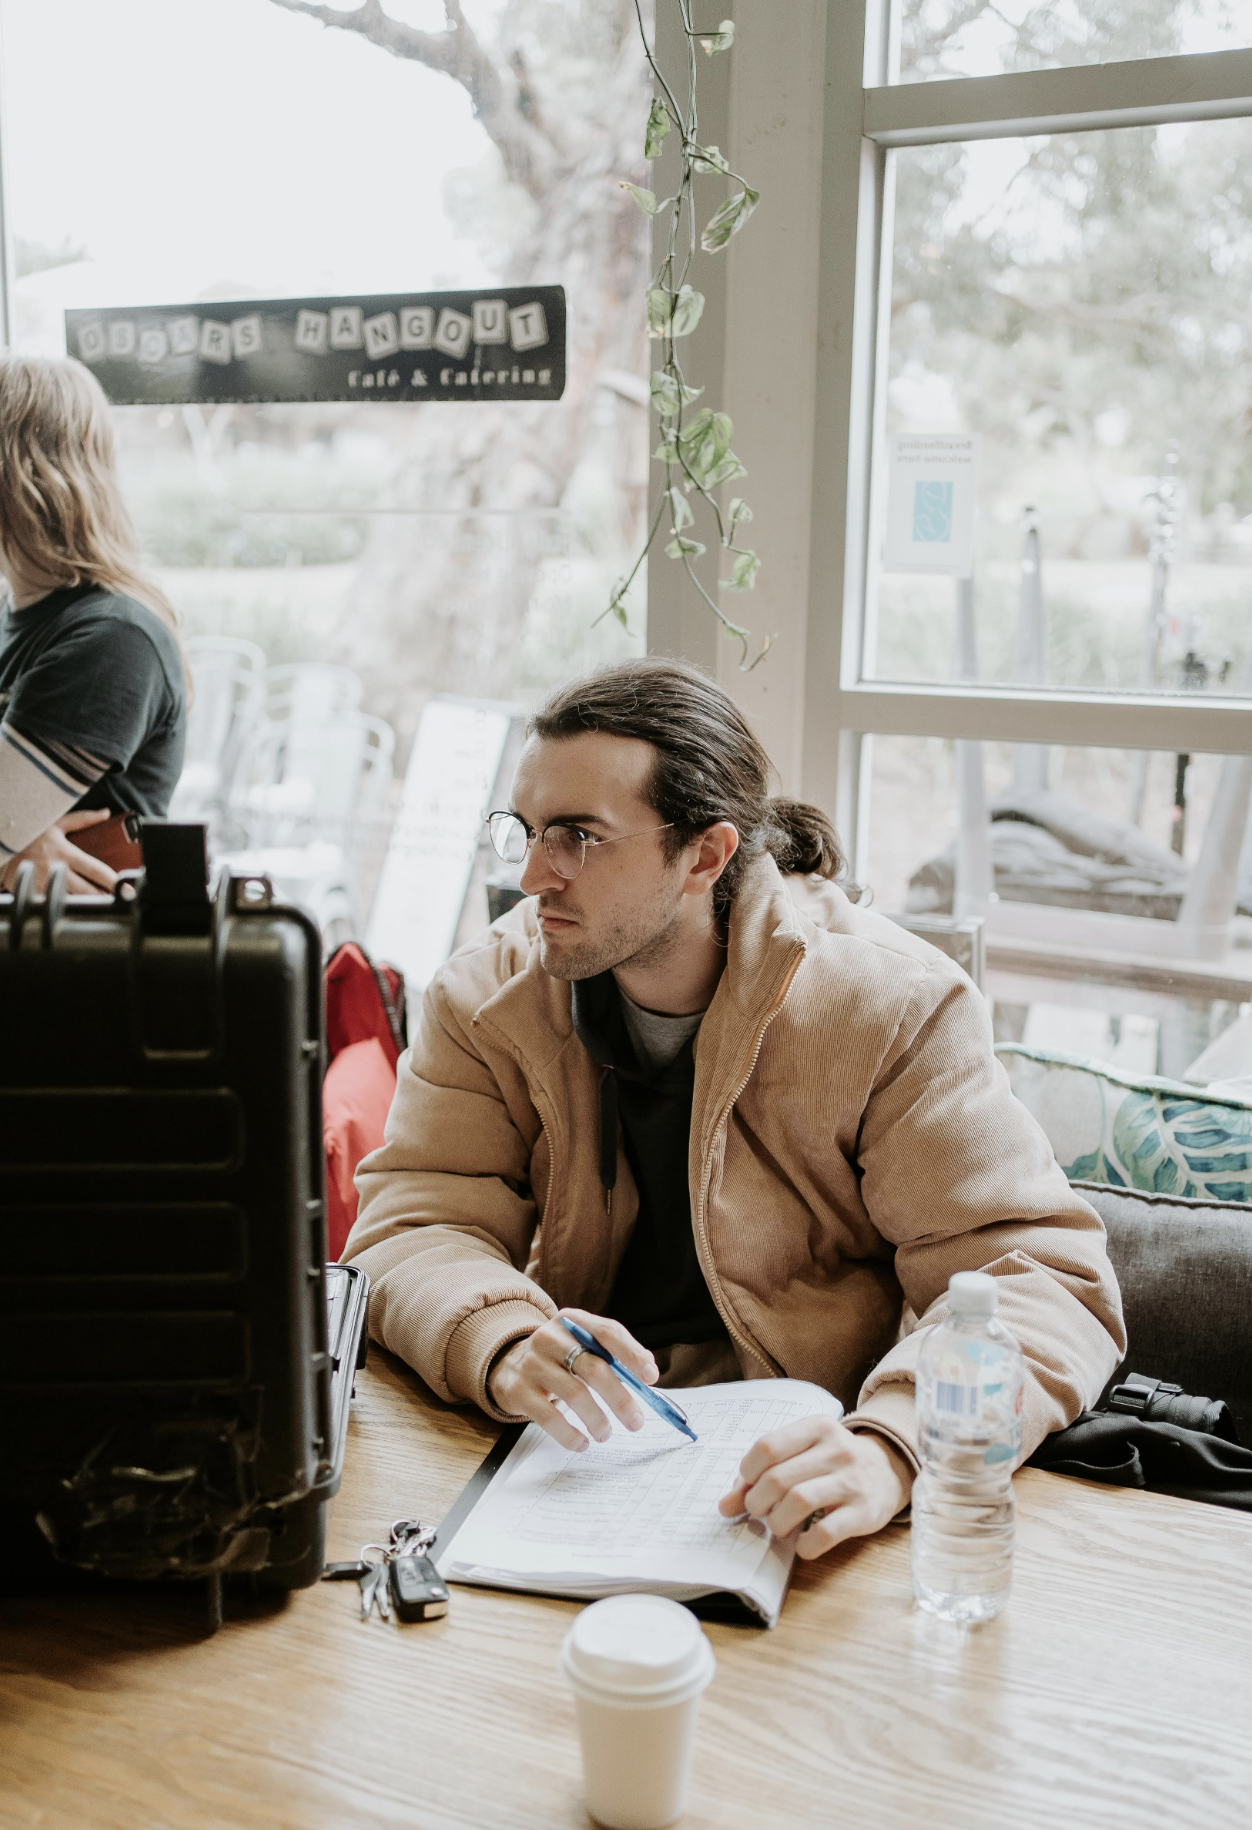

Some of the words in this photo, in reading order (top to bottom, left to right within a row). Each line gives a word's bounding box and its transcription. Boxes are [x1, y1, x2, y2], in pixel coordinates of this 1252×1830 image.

[302, 306, 538, 350] HANGOUT
[411, 367, 428, 388] &
[440, 365, 551, 387] Catering
